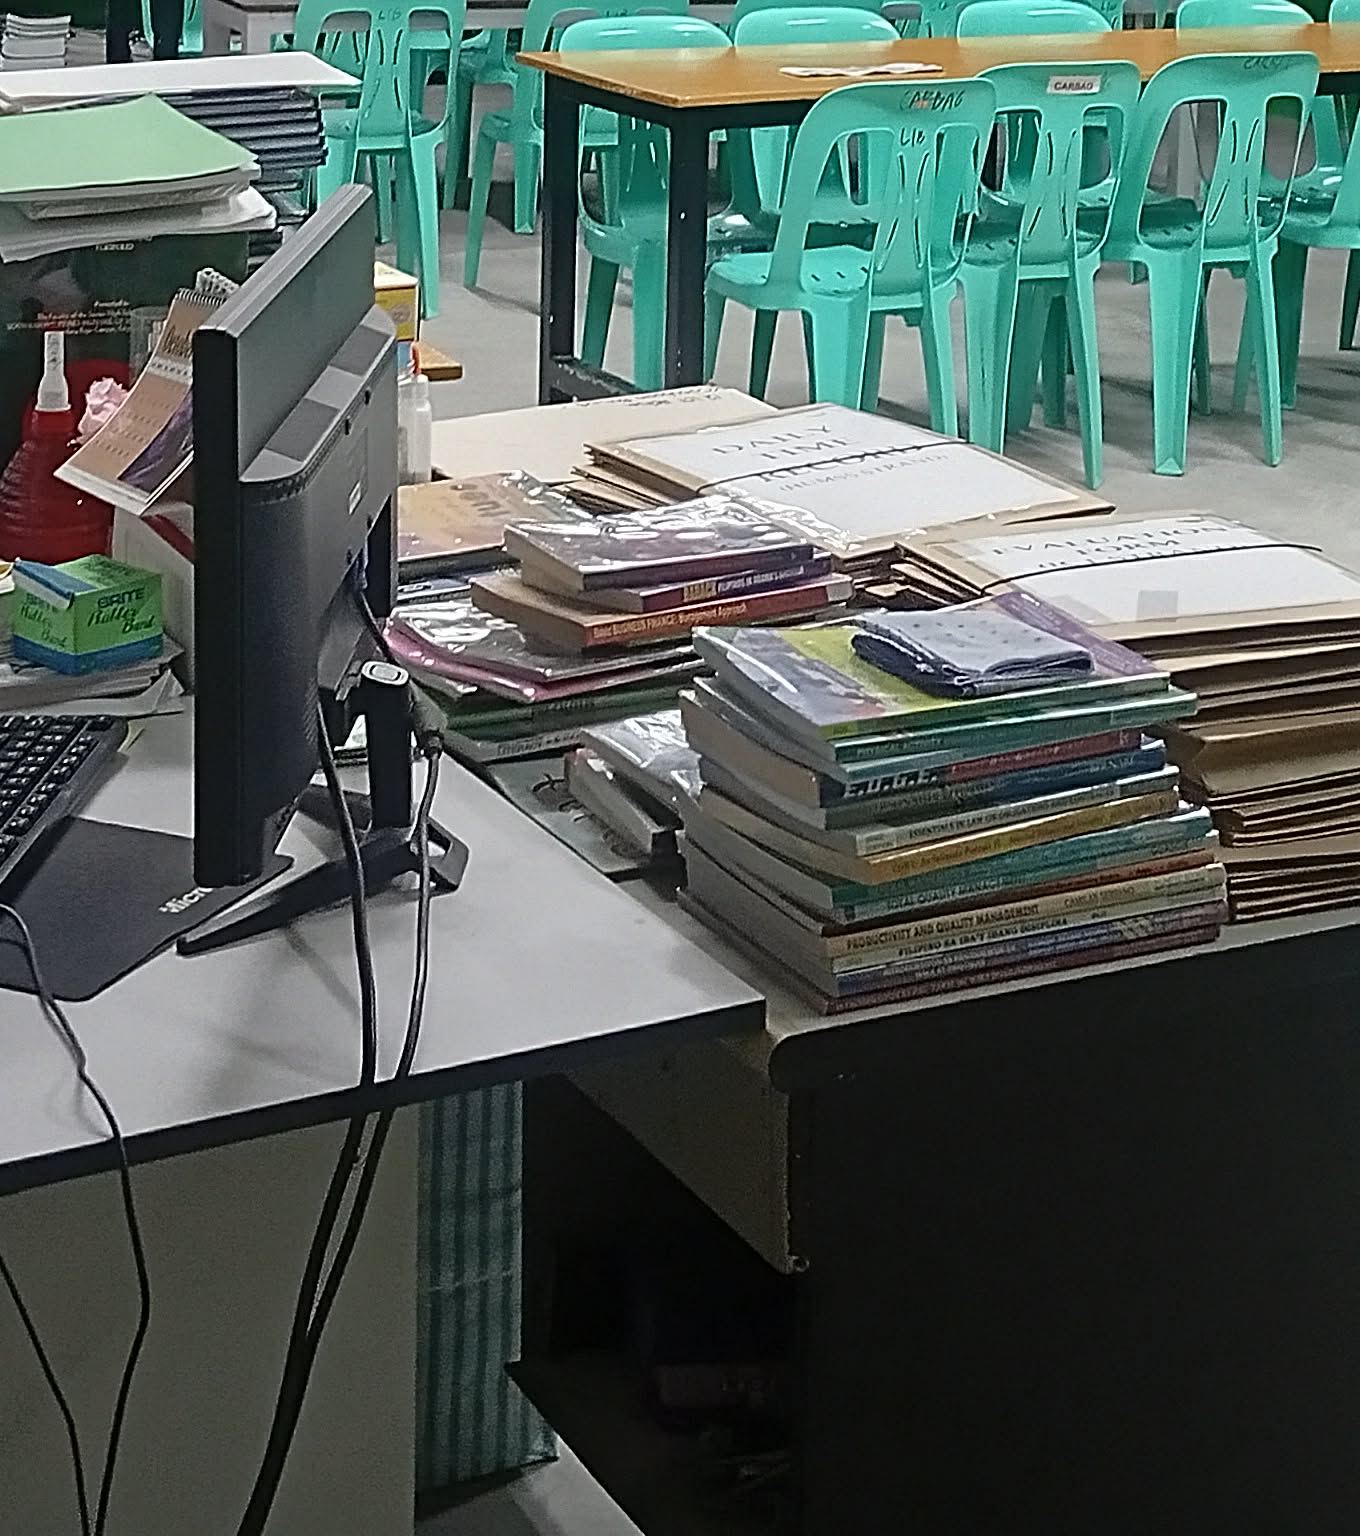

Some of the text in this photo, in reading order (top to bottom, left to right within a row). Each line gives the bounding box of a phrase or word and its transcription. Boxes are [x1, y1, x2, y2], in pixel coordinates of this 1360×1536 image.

[900, 128, 926, 146] LIB
[713, 425, 831, 454] DAILY
[760, 437, 859, 460] TIME
[992, 525, 1230, 556] EVALUATION
[1076, 539, 1183, 557] FORM
[612, 620, 647, 637] BUSINESS
[886, 893, 914, 910] TOTAL
[917, 886, 955, 907] QUALITY
[846, 927, 911, 951] PRODUCTIVITY
[913, 923, 936, 940] AND
[936, 916, 974, 938] QUALITY
[973, 904, 1040, 932] MANAGEMENT
[898, 939, 943, 957] FILIPINO
